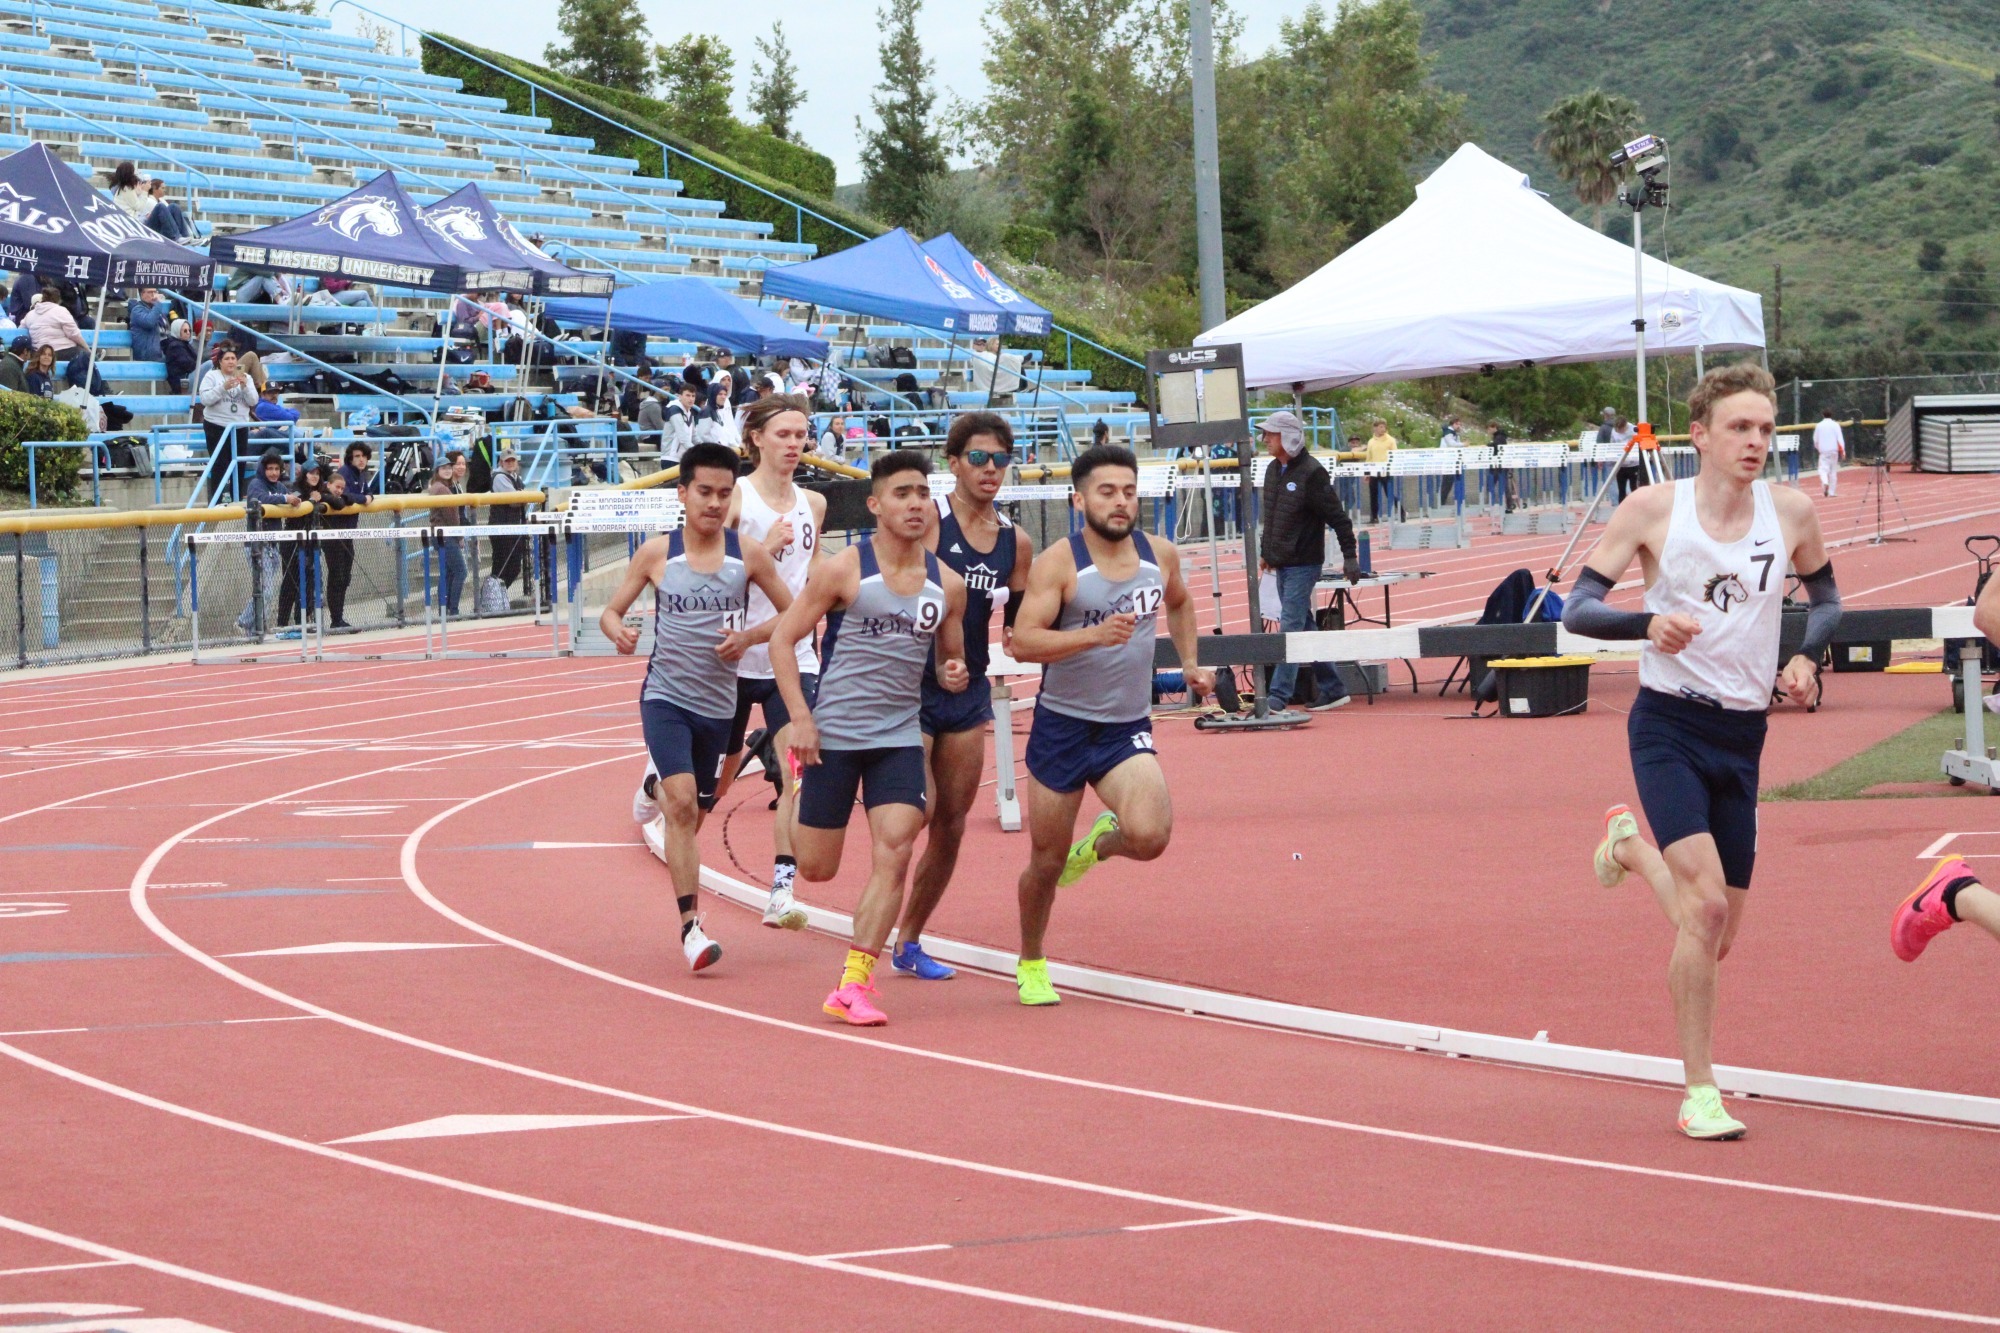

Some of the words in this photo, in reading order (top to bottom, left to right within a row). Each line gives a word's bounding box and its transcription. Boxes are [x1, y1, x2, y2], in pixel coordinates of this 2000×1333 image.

[1632, 139, 1650, 150] LYNX
[0, 199, 72, 234] ALS
[135, 260, 151, 273] HOPE
[152, 261, 191, 276] INTERNATIONAL
[233, 245, 267, 264] THE
[269, 248, 340, 273] MASTER'S
[341, 256, 435, 286] UNIVERSITY
[133, 275, 190, 287] UNIVERSITY
[968, 313, 999, 332] WARRIORS
[1014, 314, 1044, 334] WARRIORS
[1177, 349, 1218, 361] UCS
[213, 534, 248, 542] MOORPARK
[249, 532, 277, 541] COLLEGE
[337, 530, 372, 539] MOORPARK
[373, 529, 401, 538] COLLEGE
[592, 524, 627, 532] MOORPARK
[628, 523, 657, 532] COLLEGE
[802, 522, 814, 551] 8
[964, 572, 998, 592] HIU
[1749, 553, 1775, 592] 7
[667, 593, 741, 614] ROYALS
[1135, 588, 1162, 613] 12
[725, 611, 744, 632] 11
[919, 601, 939, 631] 9
